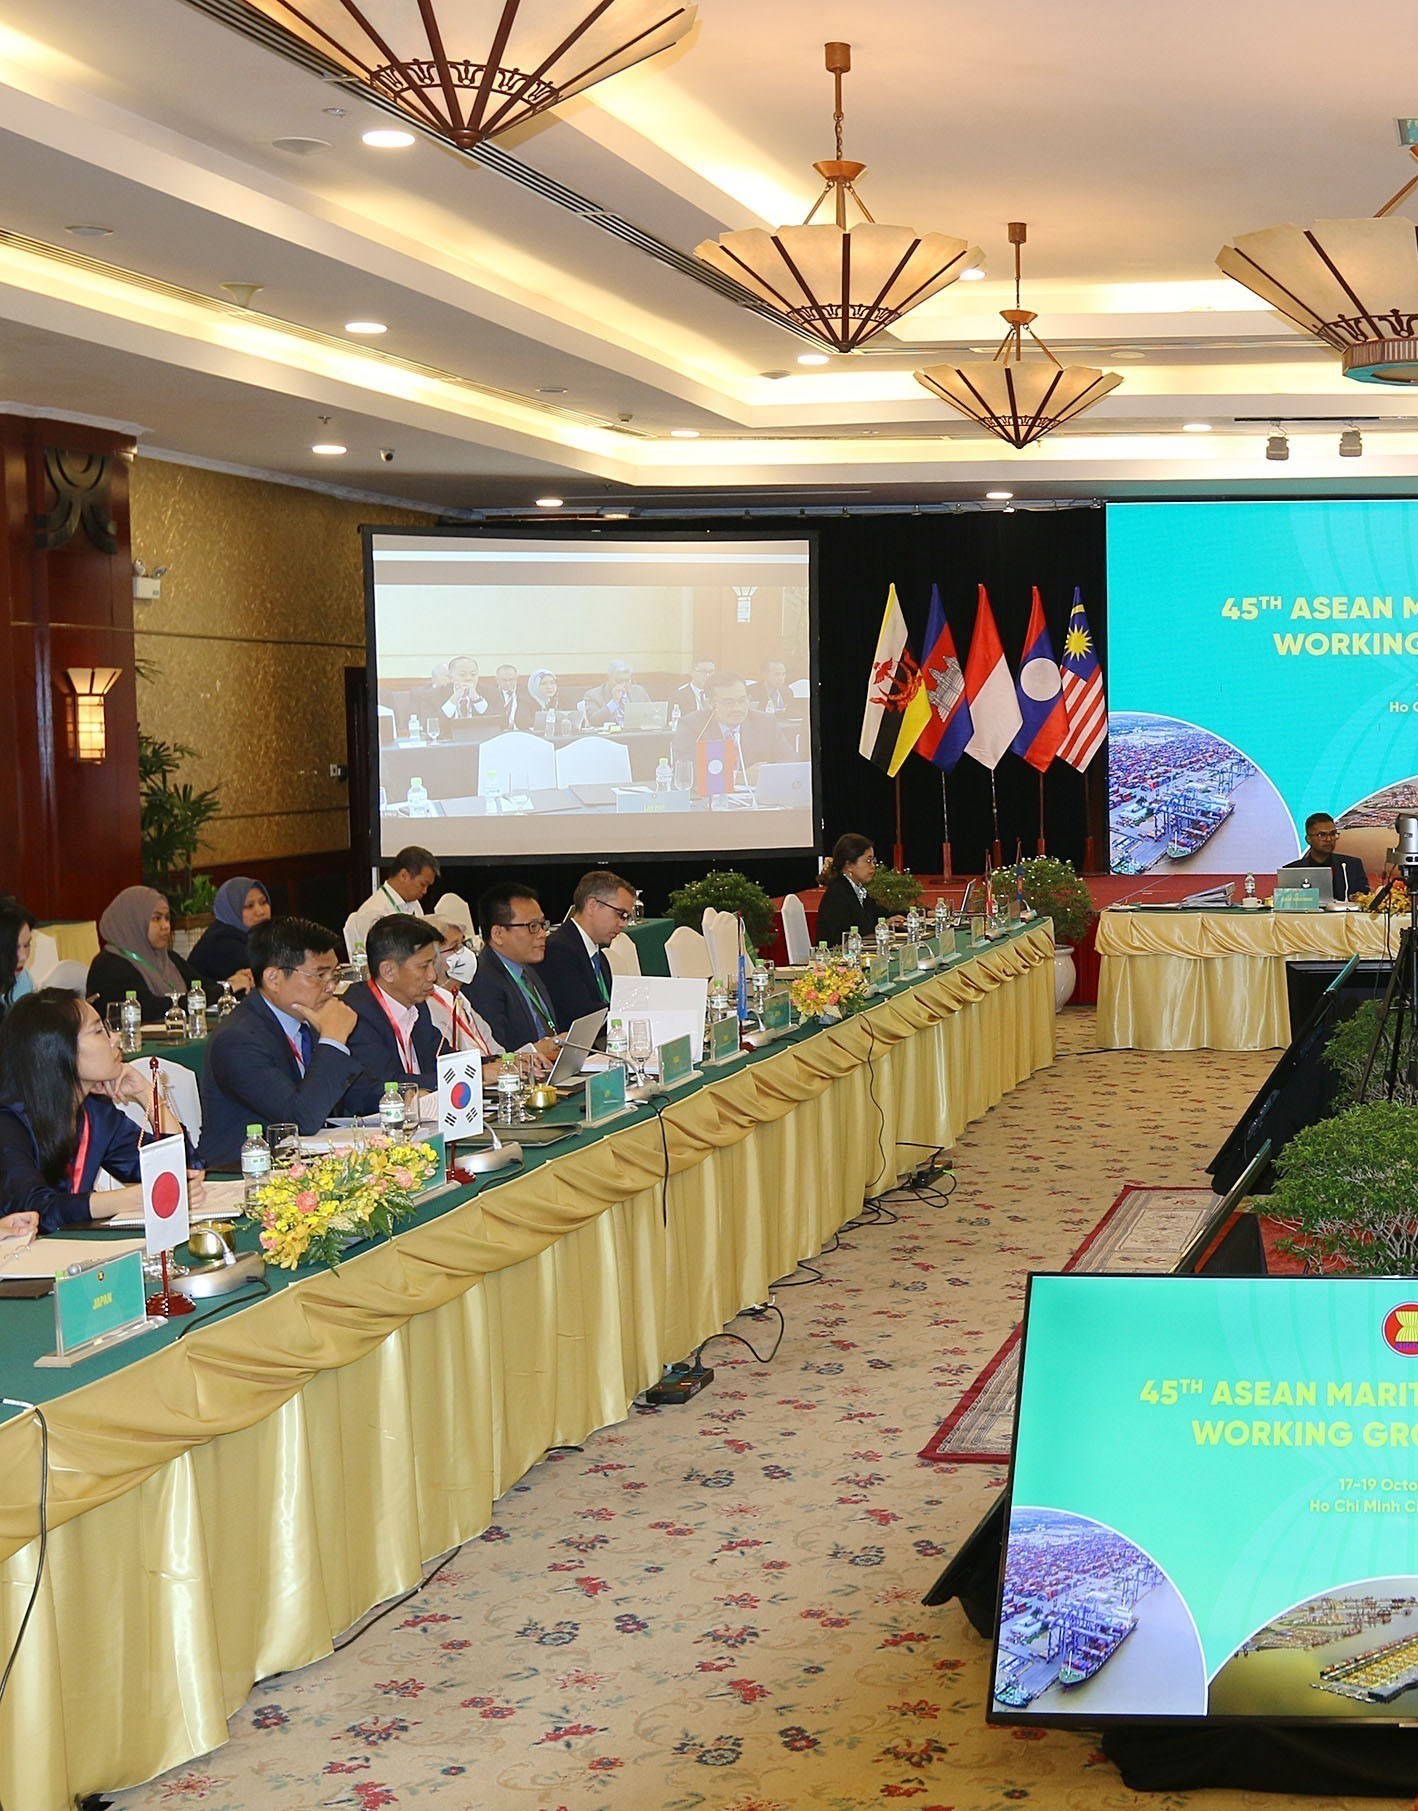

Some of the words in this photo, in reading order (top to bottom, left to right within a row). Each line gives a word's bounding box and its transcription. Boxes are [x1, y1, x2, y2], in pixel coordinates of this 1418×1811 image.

[1221, 596, 1282, 620] 45TH
[1290, 596, 1393, 620] ASEAN
[1389, 701, 1409, 712] Ho
[92, 1292, 113, 1310] JAPAN
[1140, 1379, 1203, 1405] 45TH
[1211, 1381, 1317, 1406] ASEAN
[1192, 1420, 1353, 1447] WORKING
[1339, 1477, 1378, 1491] 17-19
[1309, 1500, 1331, 1513] Ho
[1334, 1499, 1361, 1513] Chi
[1363, 1499, 1402, 1513] Minh
